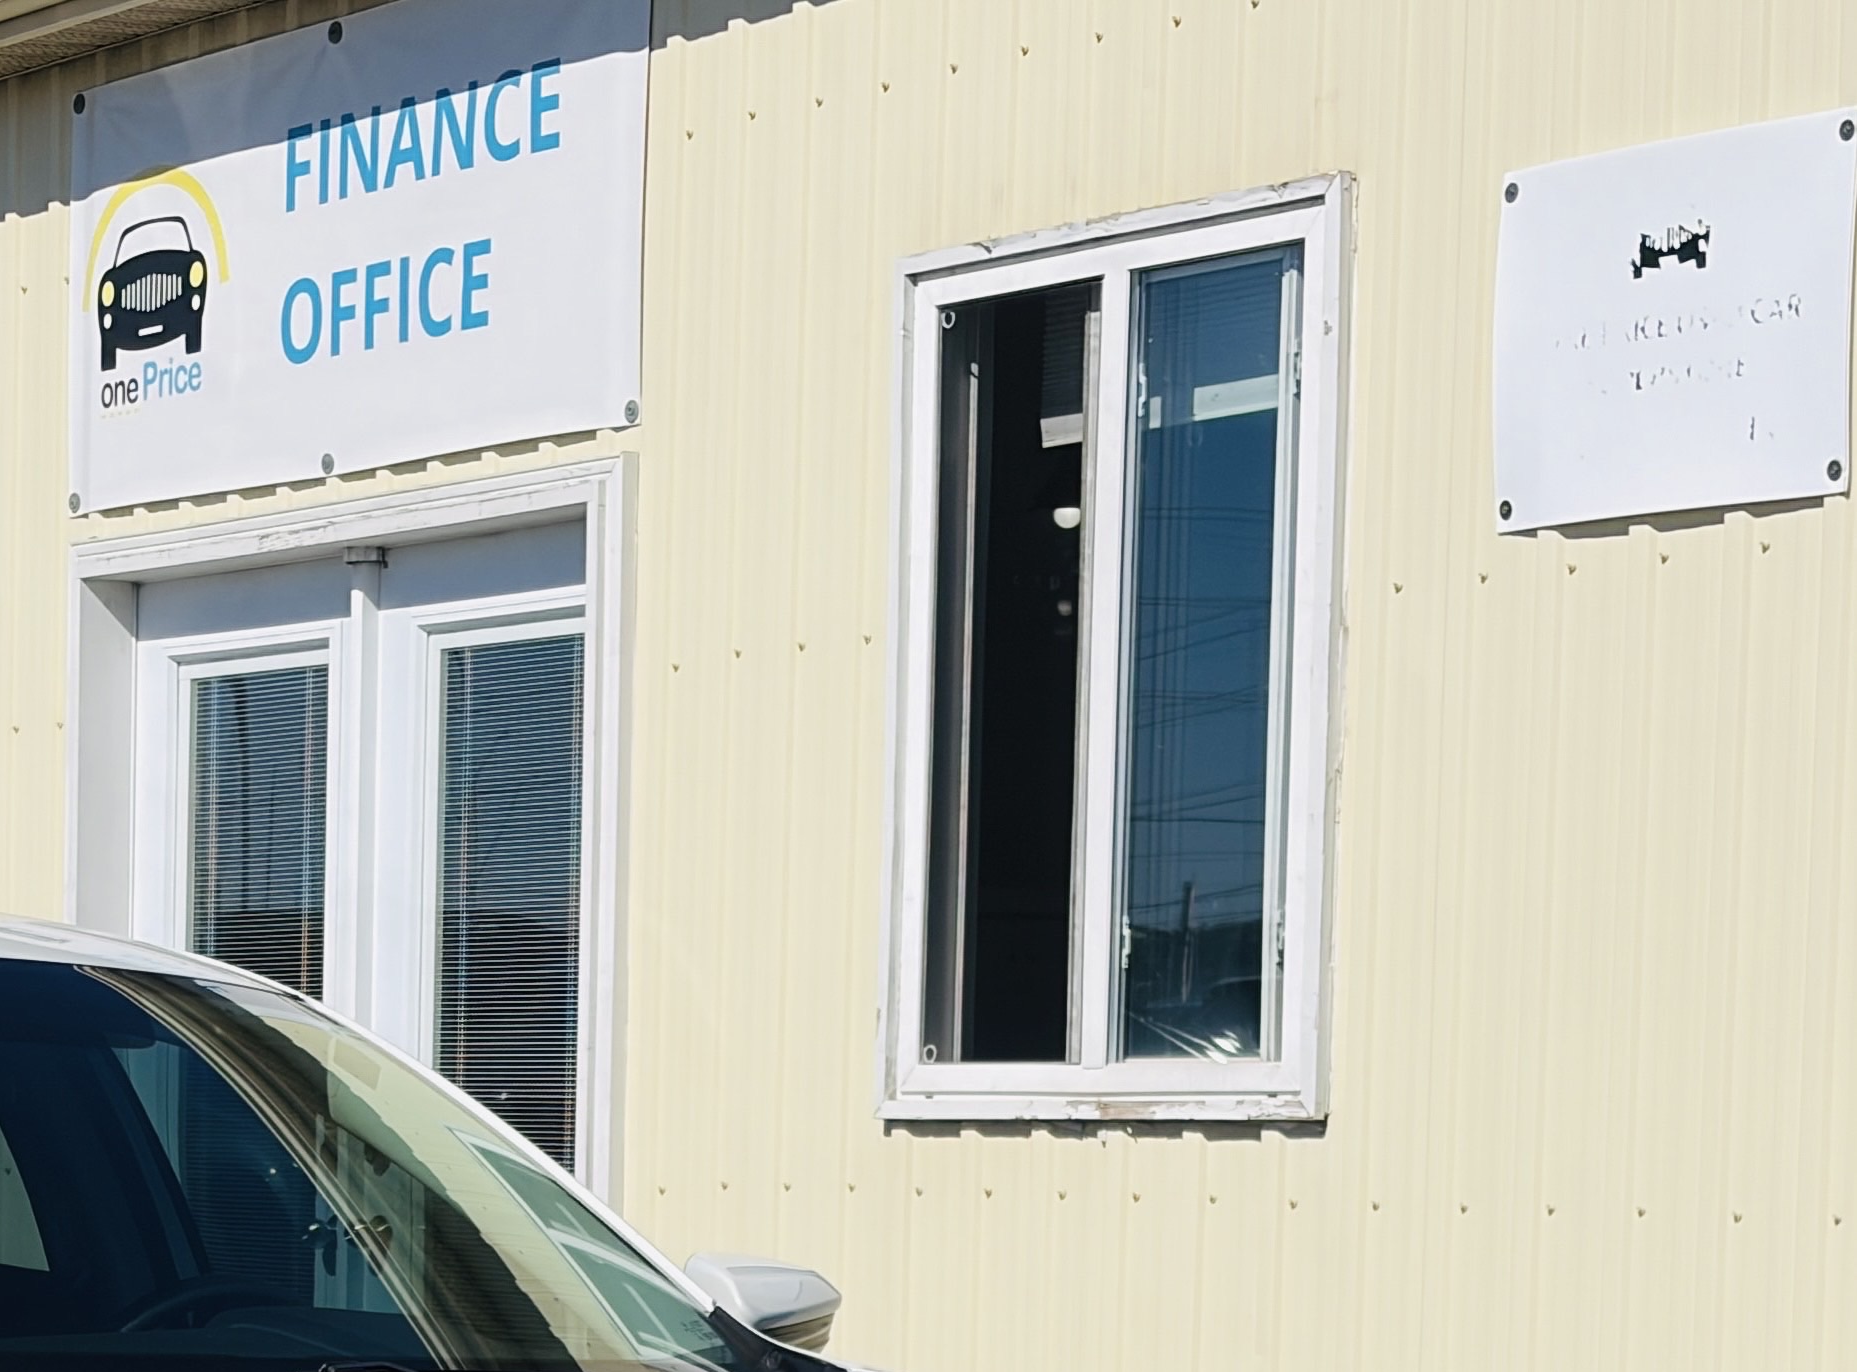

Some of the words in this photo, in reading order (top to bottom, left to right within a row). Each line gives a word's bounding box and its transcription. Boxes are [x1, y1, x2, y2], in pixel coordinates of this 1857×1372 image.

[285, 58, 561, 212] FINANCE
[280, 238, 492, 365] OFFICE
[101, 378, 139, 408] one
[143, 357, 202, 401] Price
